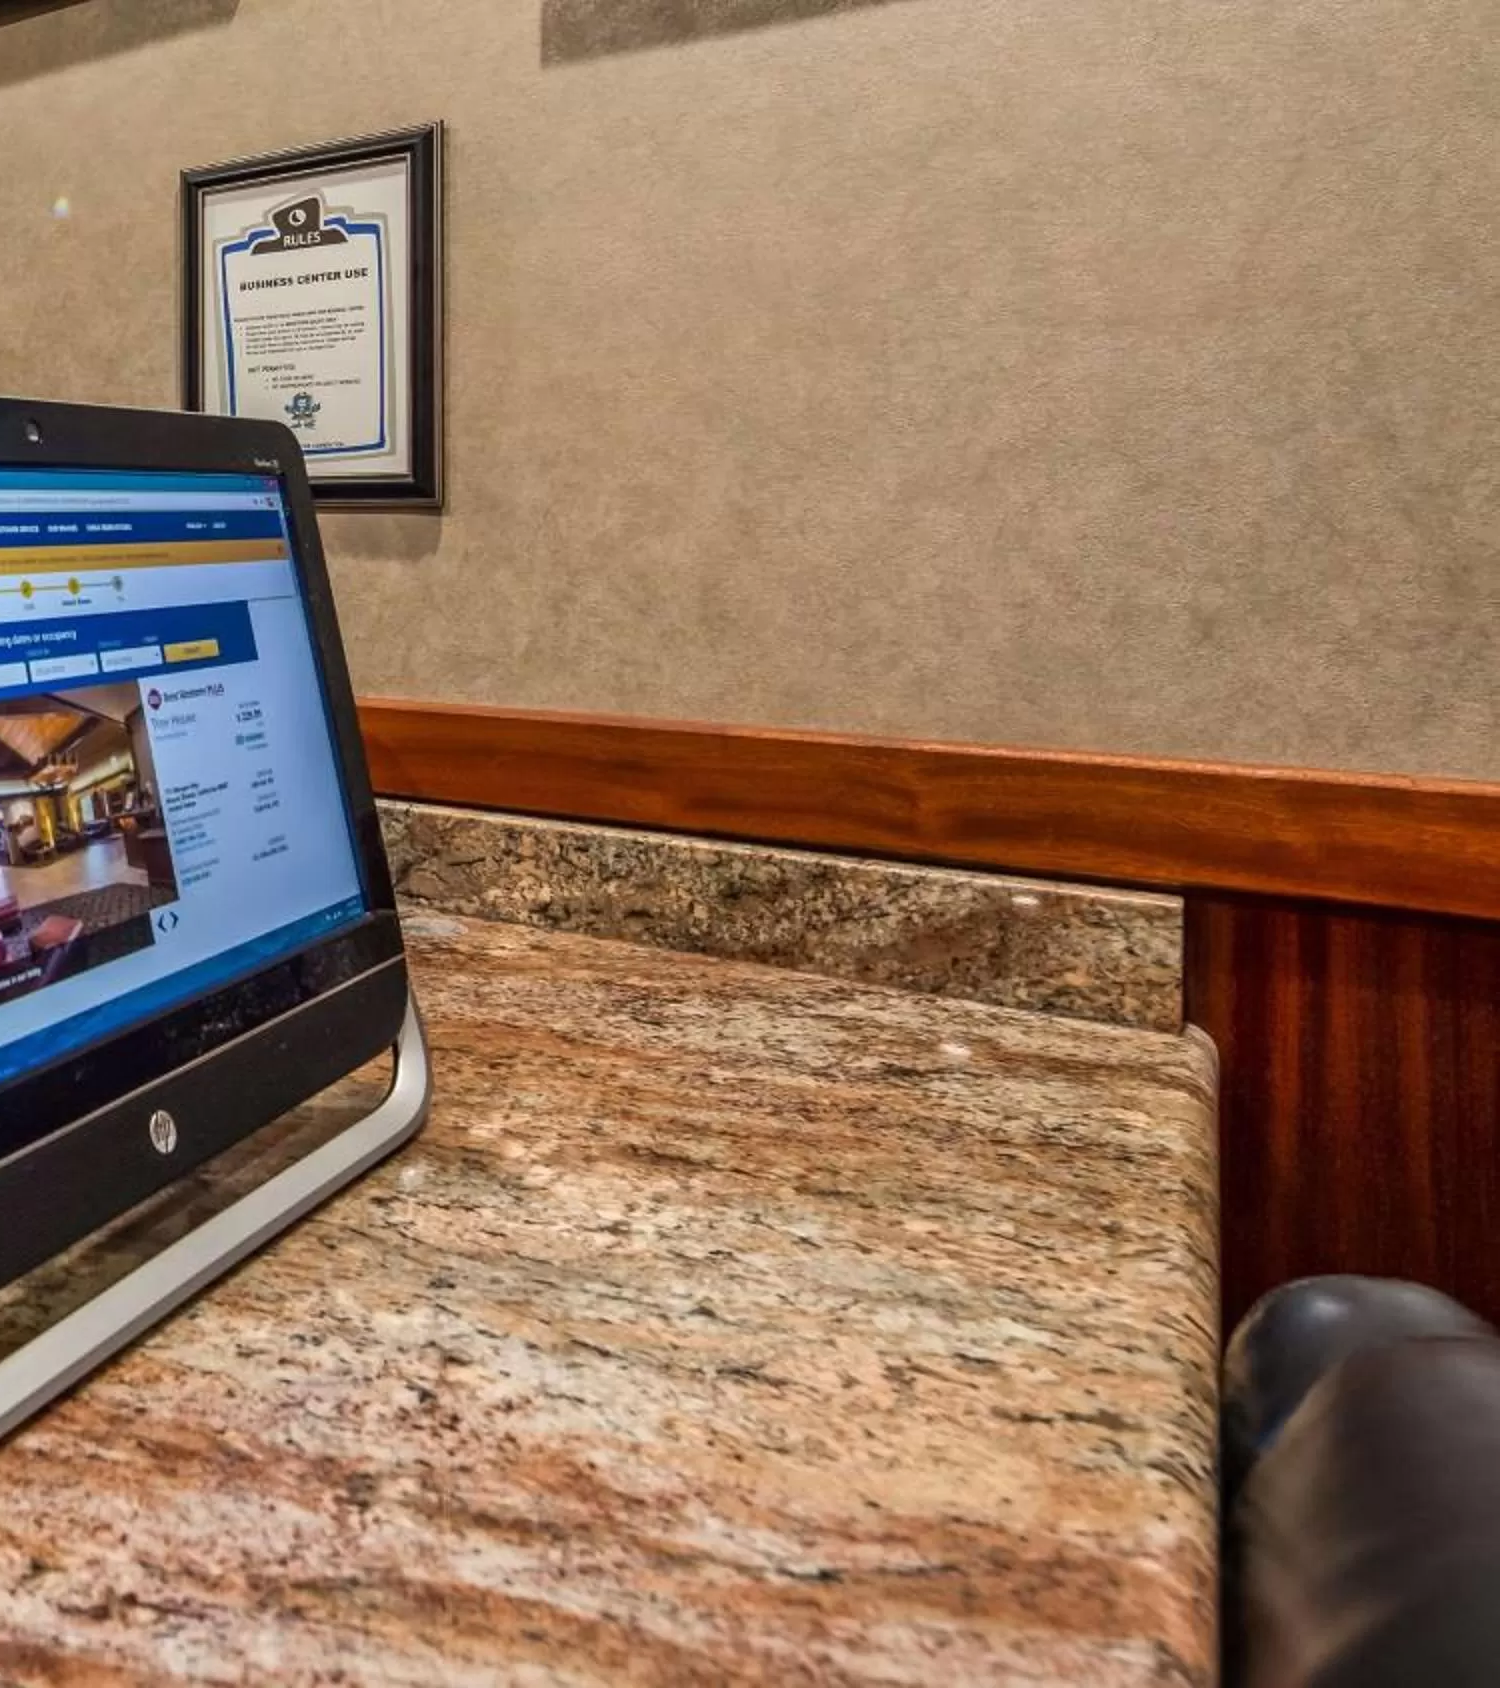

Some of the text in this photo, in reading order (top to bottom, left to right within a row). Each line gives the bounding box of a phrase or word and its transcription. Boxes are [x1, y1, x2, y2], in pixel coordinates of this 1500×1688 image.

[283, 231, 321, 247] RULES
[239, 267, 368, 291] BUSINESS CENTER USE
